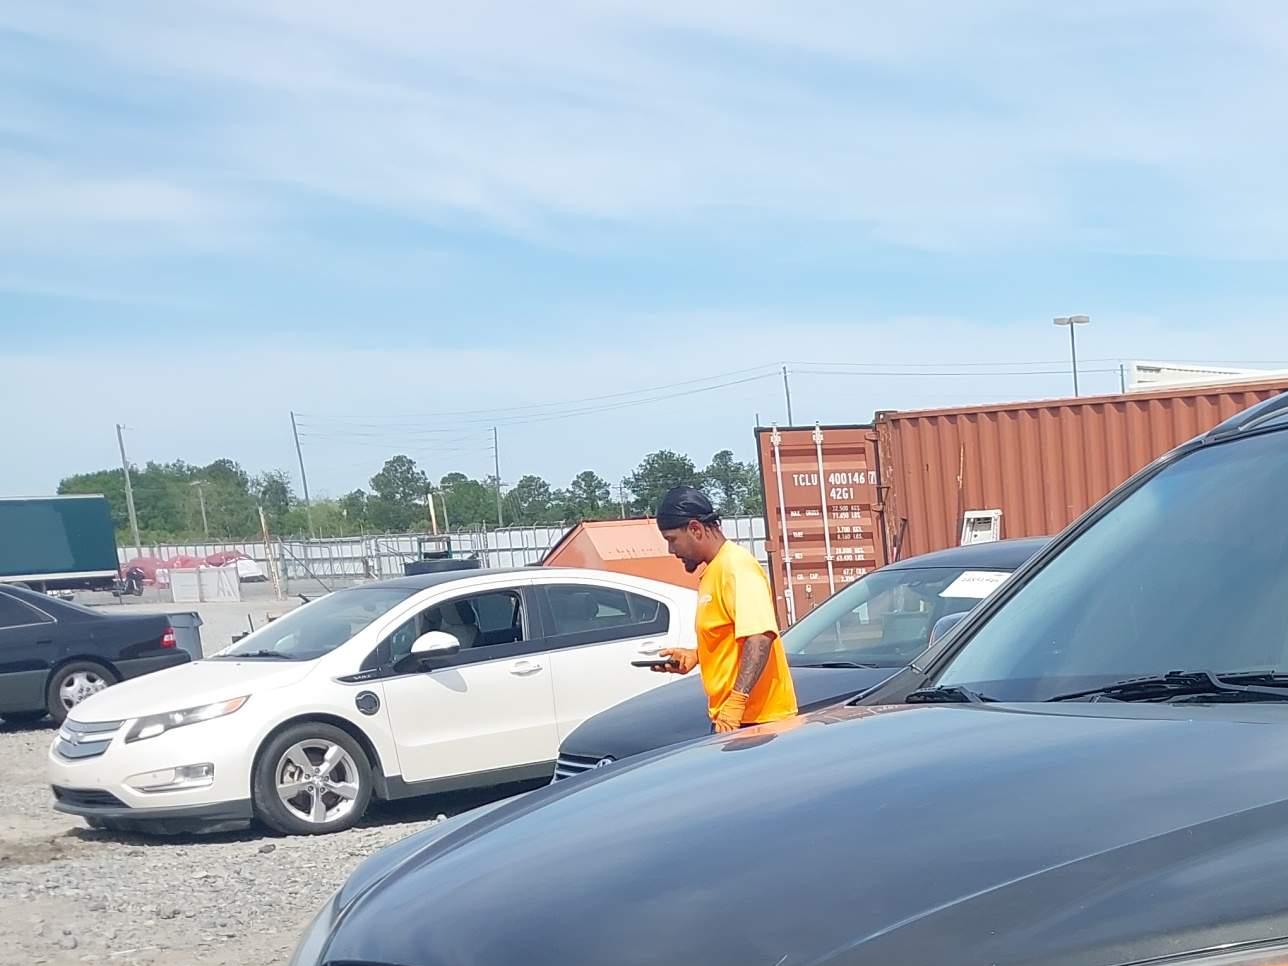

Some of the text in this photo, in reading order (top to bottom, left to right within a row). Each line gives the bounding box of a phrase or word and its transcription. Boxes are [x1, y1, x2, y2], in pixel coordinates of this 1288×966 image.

[793, 473, 818, 486] TCLU
[828, 472, 866, 485] 400146
[830, 487, 854, 500] 42G1
